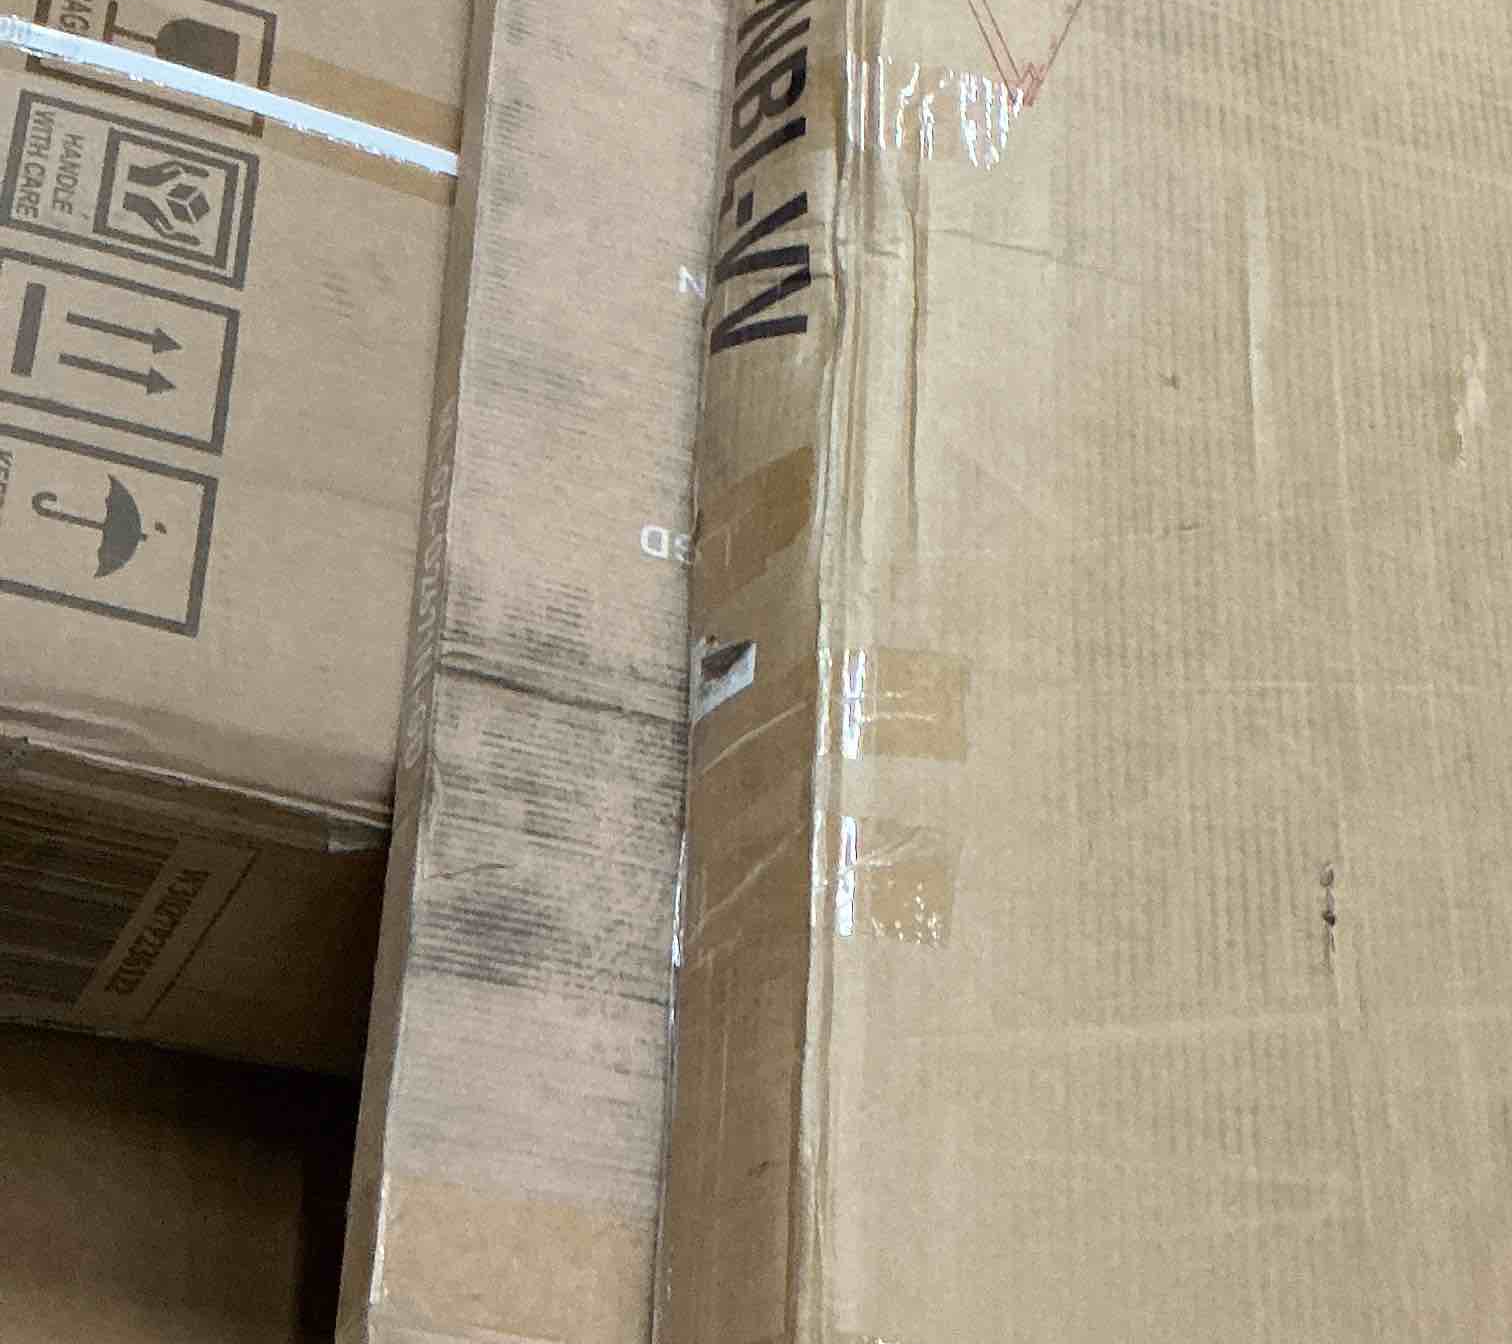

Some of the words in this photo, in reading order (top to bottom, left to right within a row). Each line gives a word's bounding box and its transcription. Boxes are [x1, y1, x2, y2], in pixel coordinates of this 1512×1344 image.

[27, 110, 56, 160] WITH
[15, 161, 46, 219] CARE
[52, 133, 85, 216] HANDLE
